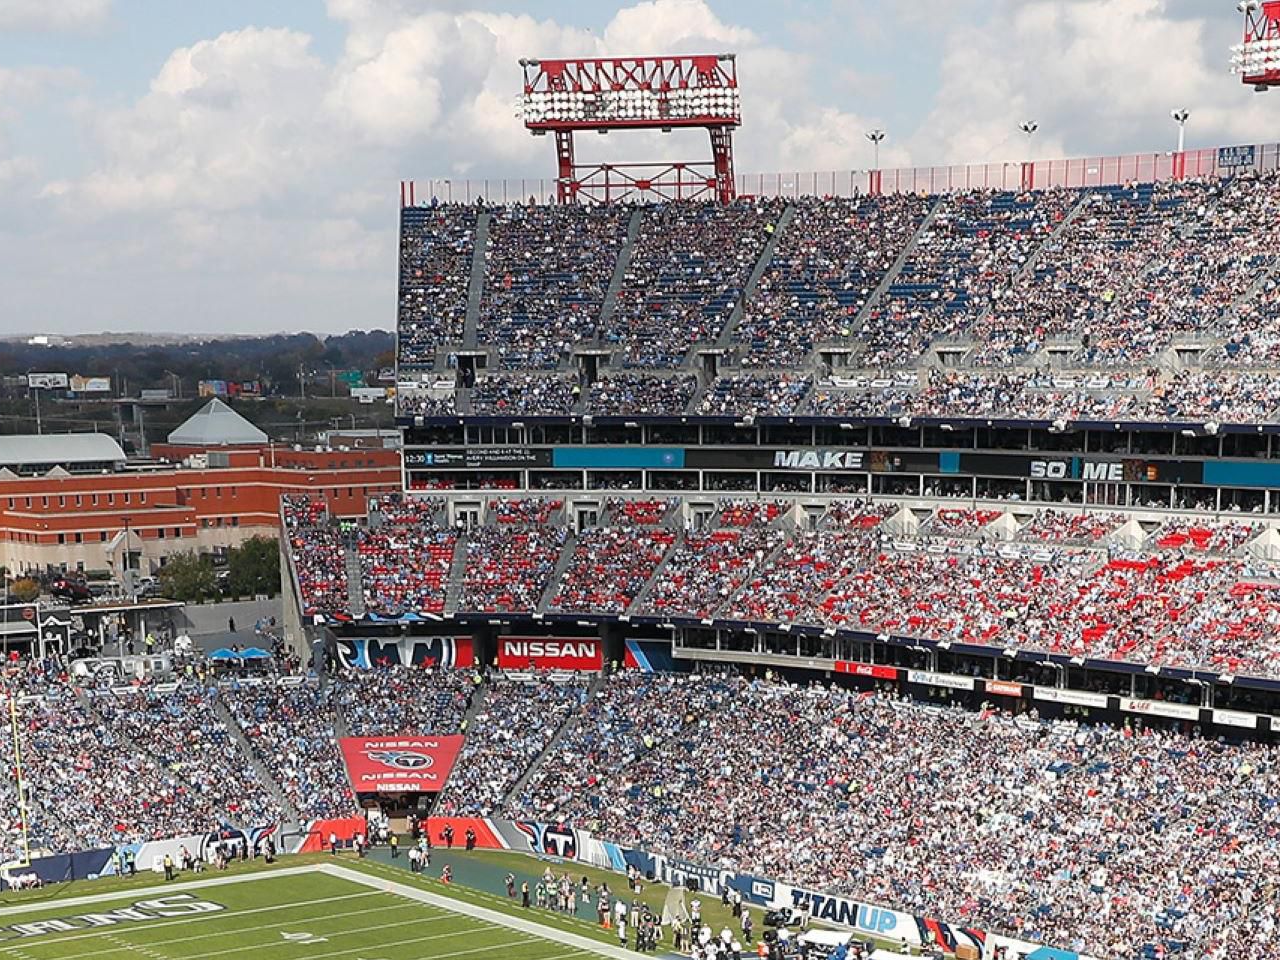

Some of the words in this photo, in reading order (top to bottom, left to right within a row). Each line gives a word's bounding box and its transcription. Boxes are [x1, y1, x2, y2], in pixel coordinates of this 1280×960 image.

[774, 451, 863, 468] MAKE
[504, 641, 596, 658] NISSAN
[364, 741, 439, 749] NISSAN
[361, 772, 437, 781] NISSAN
[376, 783, 420, 791] NISSAN
